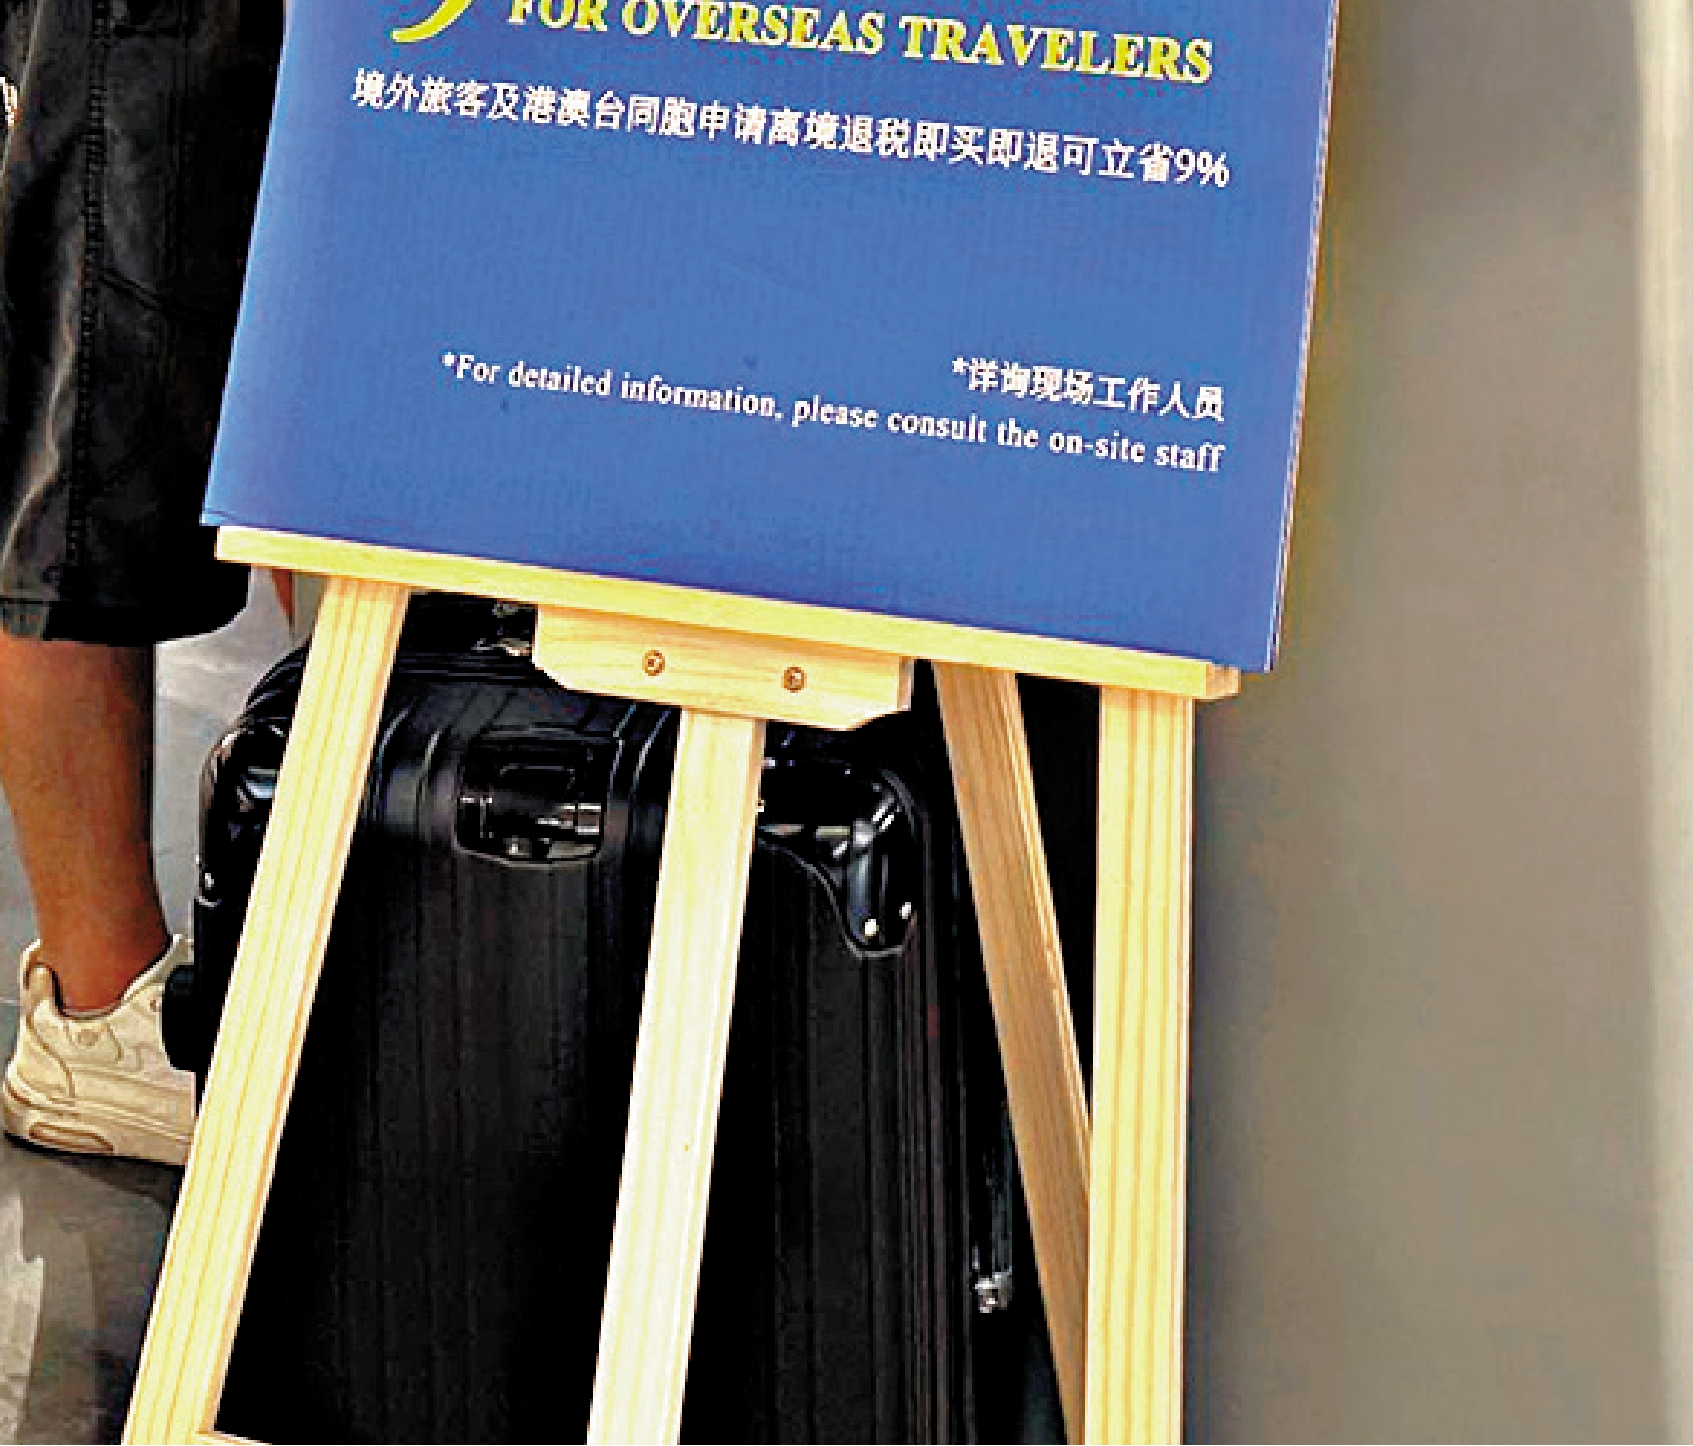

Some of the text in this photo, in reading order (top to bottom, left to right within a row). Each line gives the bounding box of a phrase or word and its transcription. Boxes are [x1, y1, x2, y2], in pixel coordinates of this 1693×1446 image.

[899, 15, 1213, 84] TRAVELERS
[352, 66, 1230, 188] 境外旅客及港澳台同胞申请离境退税即买即退可立省9%
[508, 360, 611, 396] detailed
[621, 371, 783, 419] information,
[791, 394, 878, 429] please
[887, 411, 987, 443] consult
[997, 418, 1040, 449] the
[1049, 432, 1146, 464] on-site
[1154, 441, 1227, 473] staff
